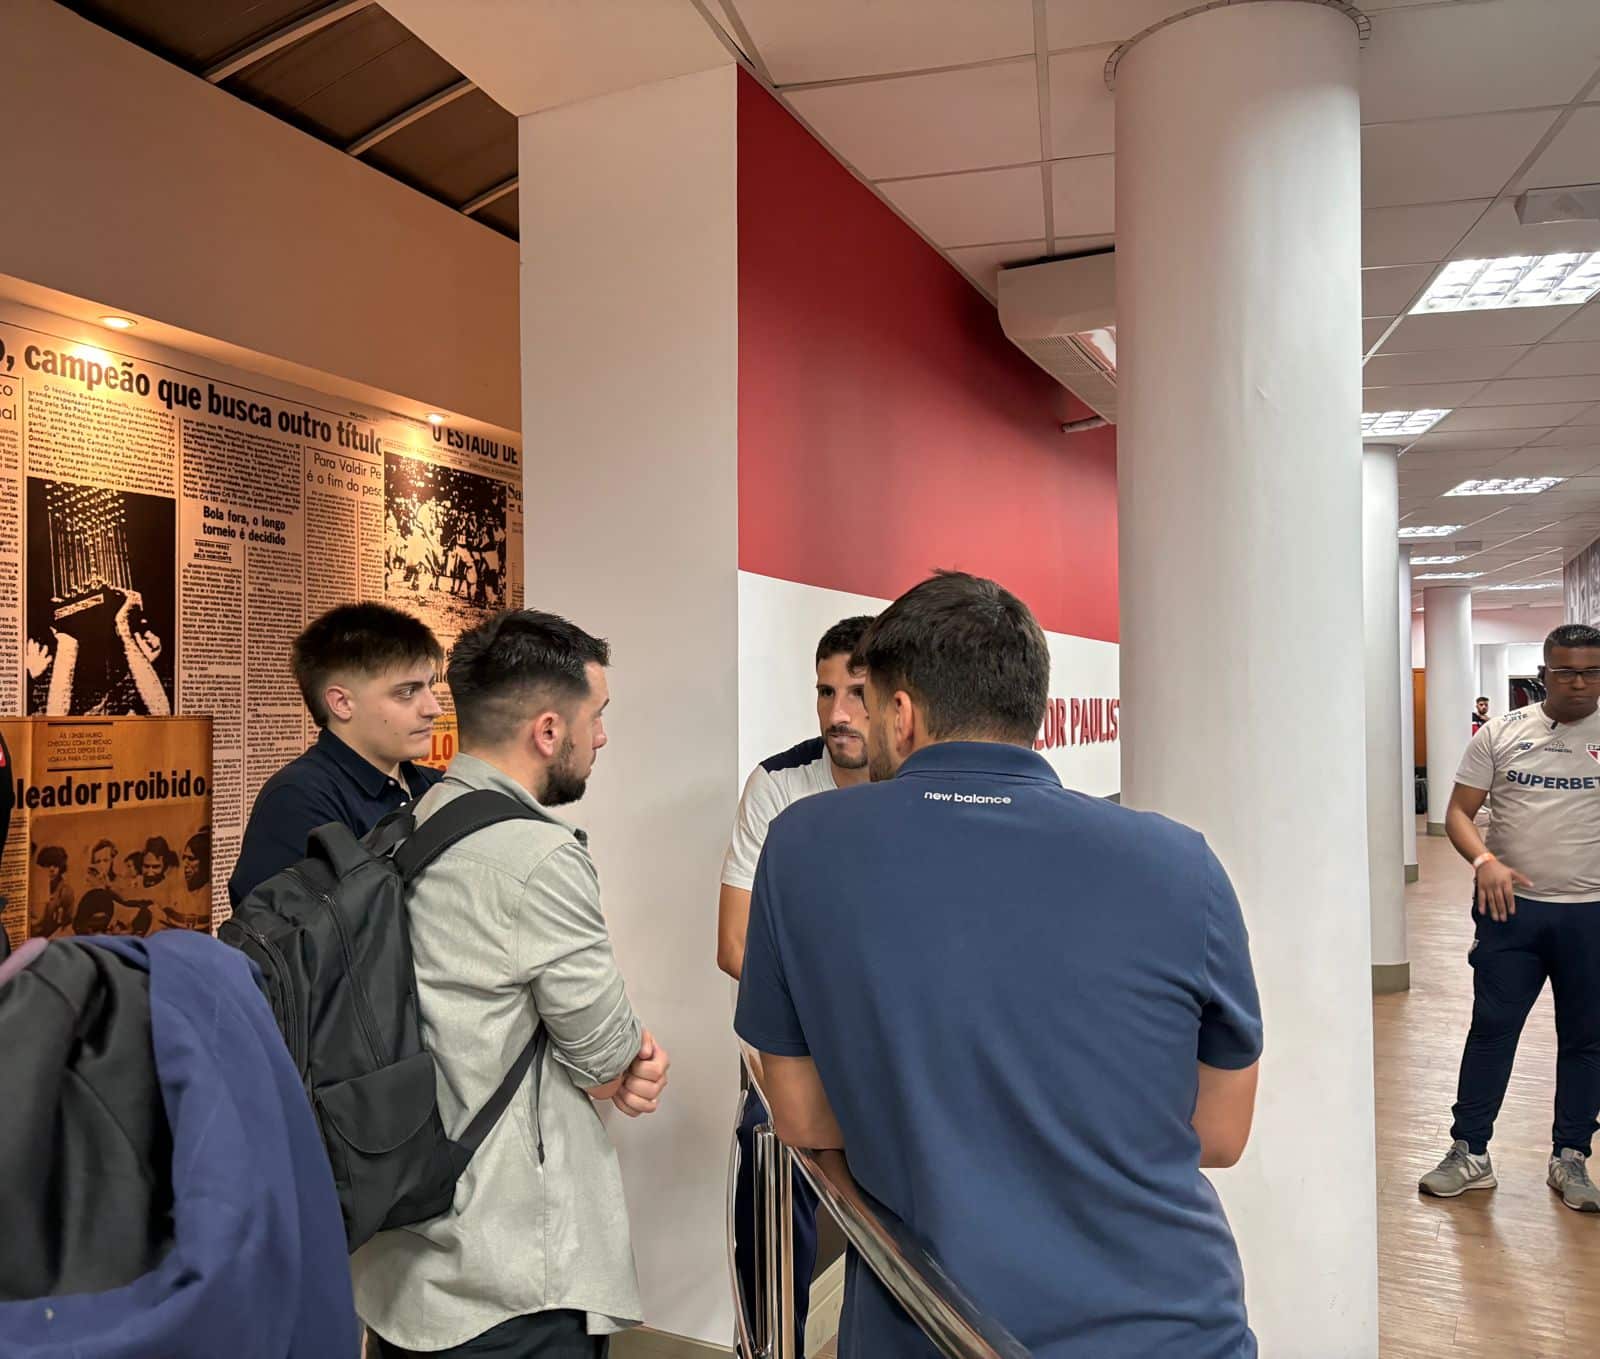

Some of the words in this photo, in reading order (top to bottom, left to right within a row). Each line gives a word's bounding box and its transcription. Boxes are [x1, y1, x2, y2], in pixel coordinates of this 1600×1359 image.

[25, 344, 150, 396] campeão
[158, 379, 201, 410] que
[208, 384, 272, 428] busca
[278, 410, 331, 442] outro
[314, 453, 335, 470] Para
[340, 459, 367, 477] Valdir
[307, 470, 313, 482] é
[317, 476, 324, 485] o
[327, 474, 343, 489] fim
[346, 478, 359, 493] do
[203, 506, 224, 521] Bola
[228, 508, 249, 526] fora,
[253, 516, 259, 526] o
[262, 515, 286, 531] longo
[203, 523, 236, 539] torneio
[239, 528, 246, 540] é
[248, 528, 286, 546] decidido
[924, 790, 952, 801] new
[954, 792, 1012, 804] balance
